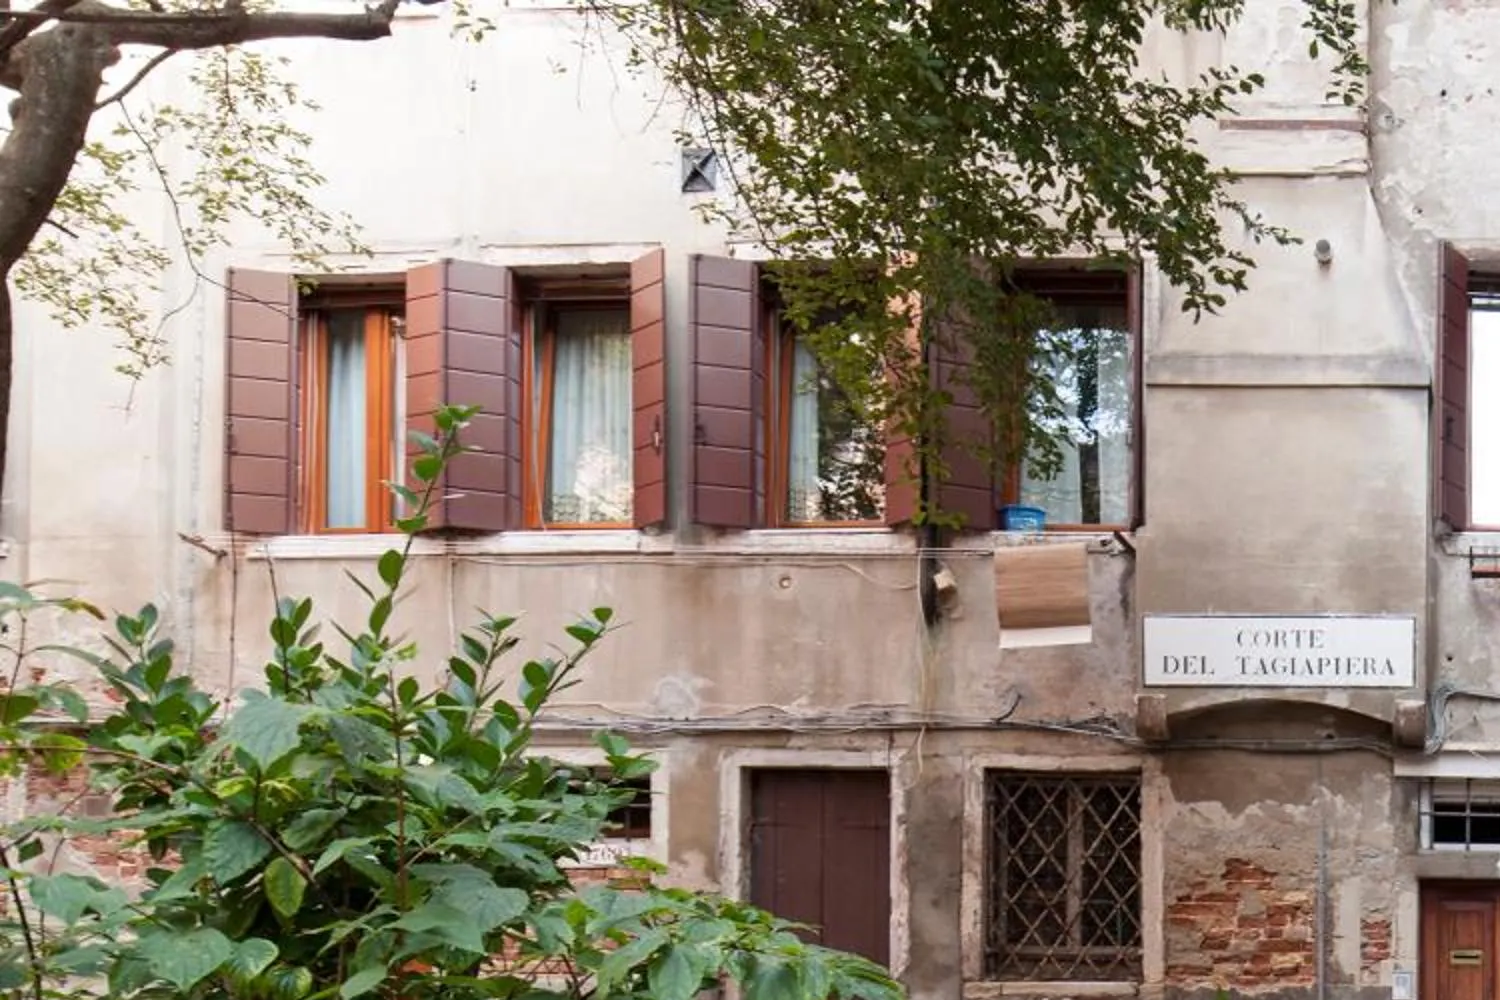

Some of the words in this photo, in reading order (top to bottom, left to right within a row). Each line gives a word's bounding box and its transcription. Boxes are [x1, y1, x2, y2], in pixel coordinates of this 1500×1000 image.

[1235, 628, 1325, 649] CORTE
[1162, 655, 1215, 675] DEL
[1234, 655, 1396, 676] TAGIAPIERA
